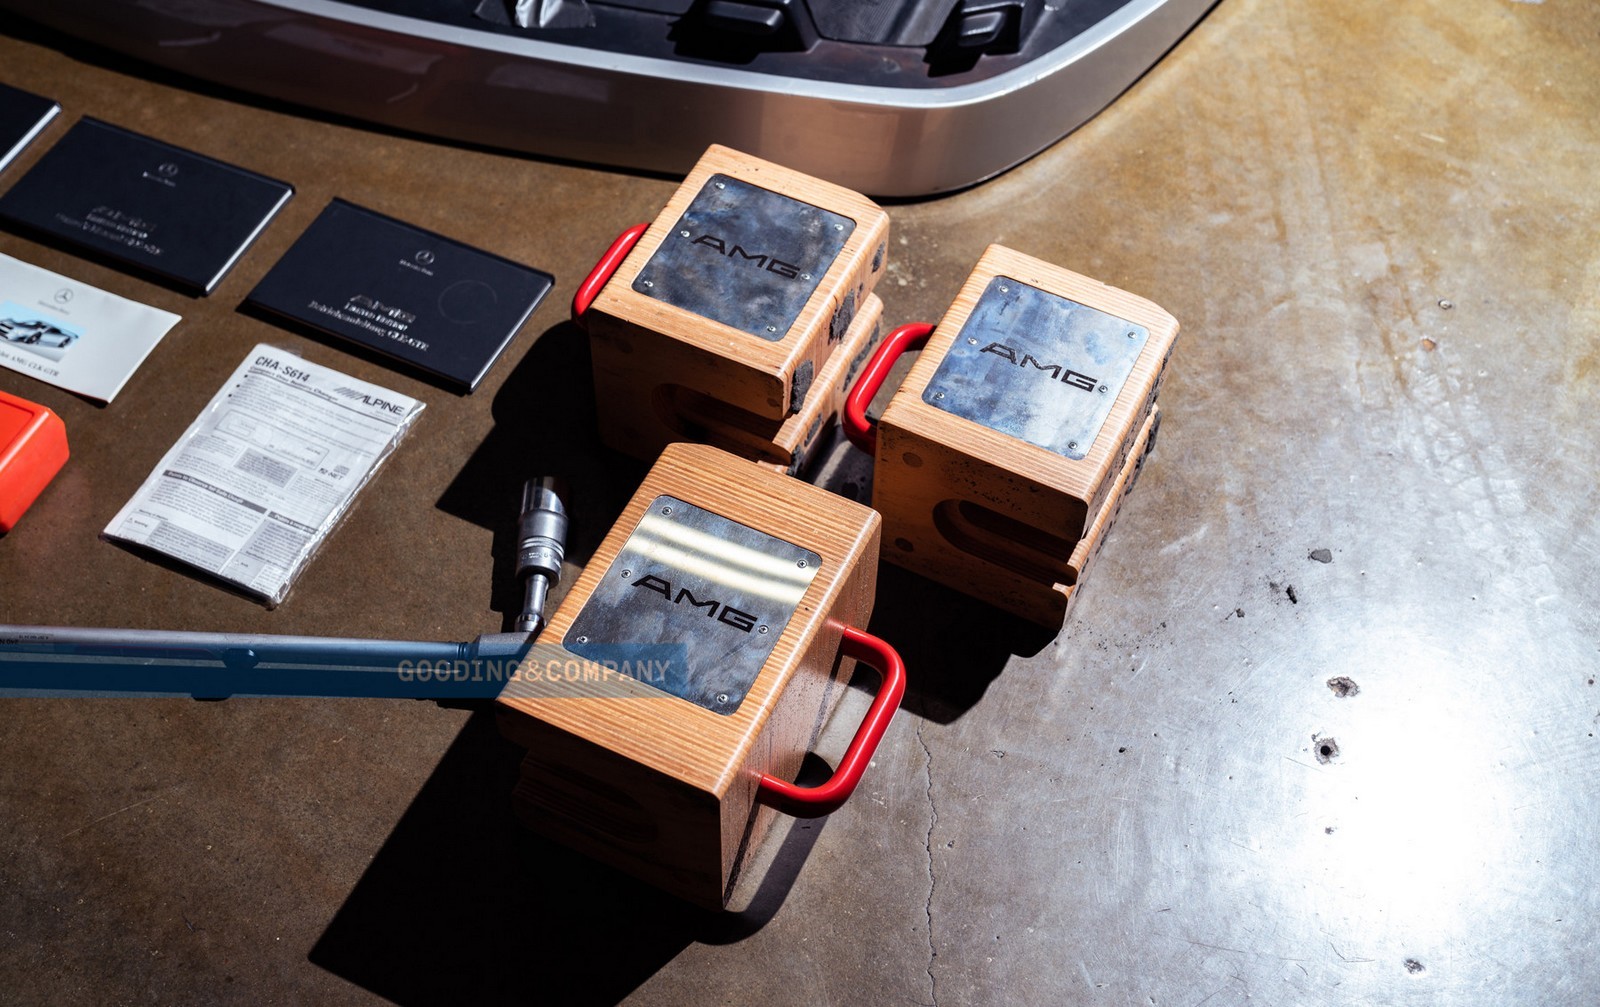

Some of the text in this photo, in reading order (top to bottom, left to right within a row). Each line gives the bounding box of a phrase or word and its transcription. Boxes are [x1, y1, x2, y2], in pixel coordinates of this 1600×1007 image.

[691, 235, 800, 280] AMG
[255, 356, 311, 382] CHA-S614
[980, 342, 1098, 393] AMG
[356, 392, 405, 416] ALPINE
[631, 574, 758, 633] AMG
